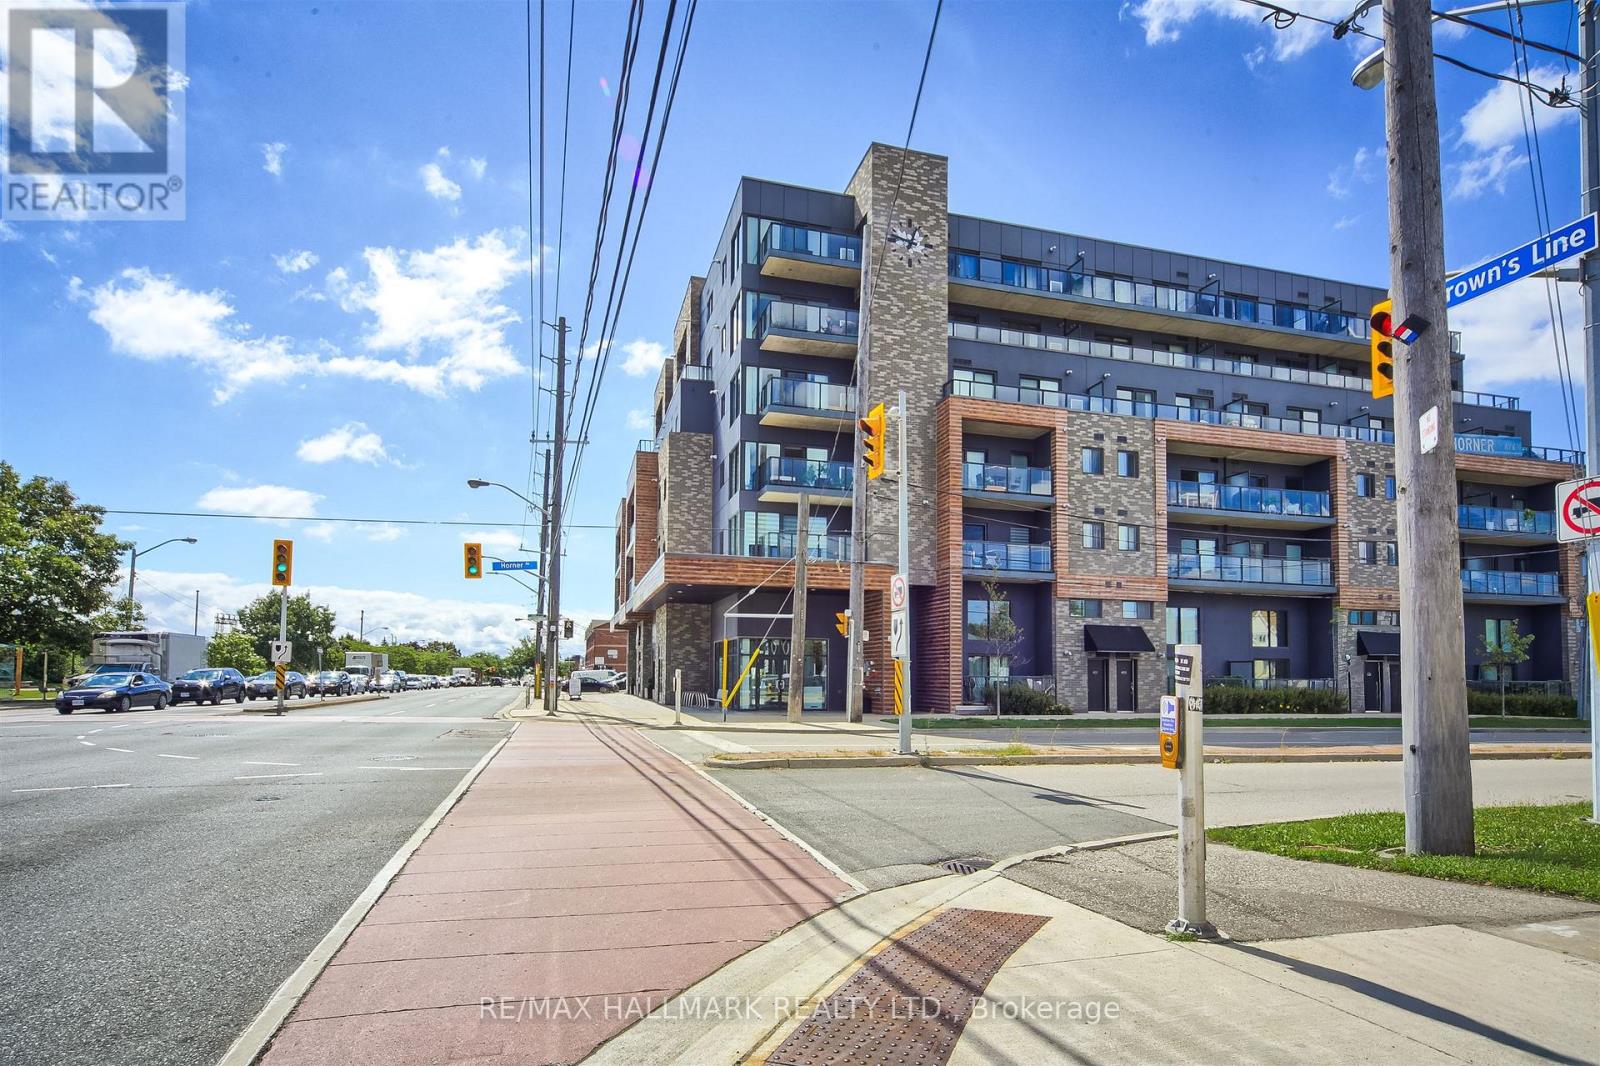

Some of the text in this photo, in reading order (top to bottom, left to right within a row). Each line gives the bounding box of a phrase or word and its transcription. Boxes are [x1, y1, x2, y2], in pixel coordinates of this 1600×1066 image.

[1446, 227, 1586, 303] rown's Line
[500, 561, 523, 569] Horner
